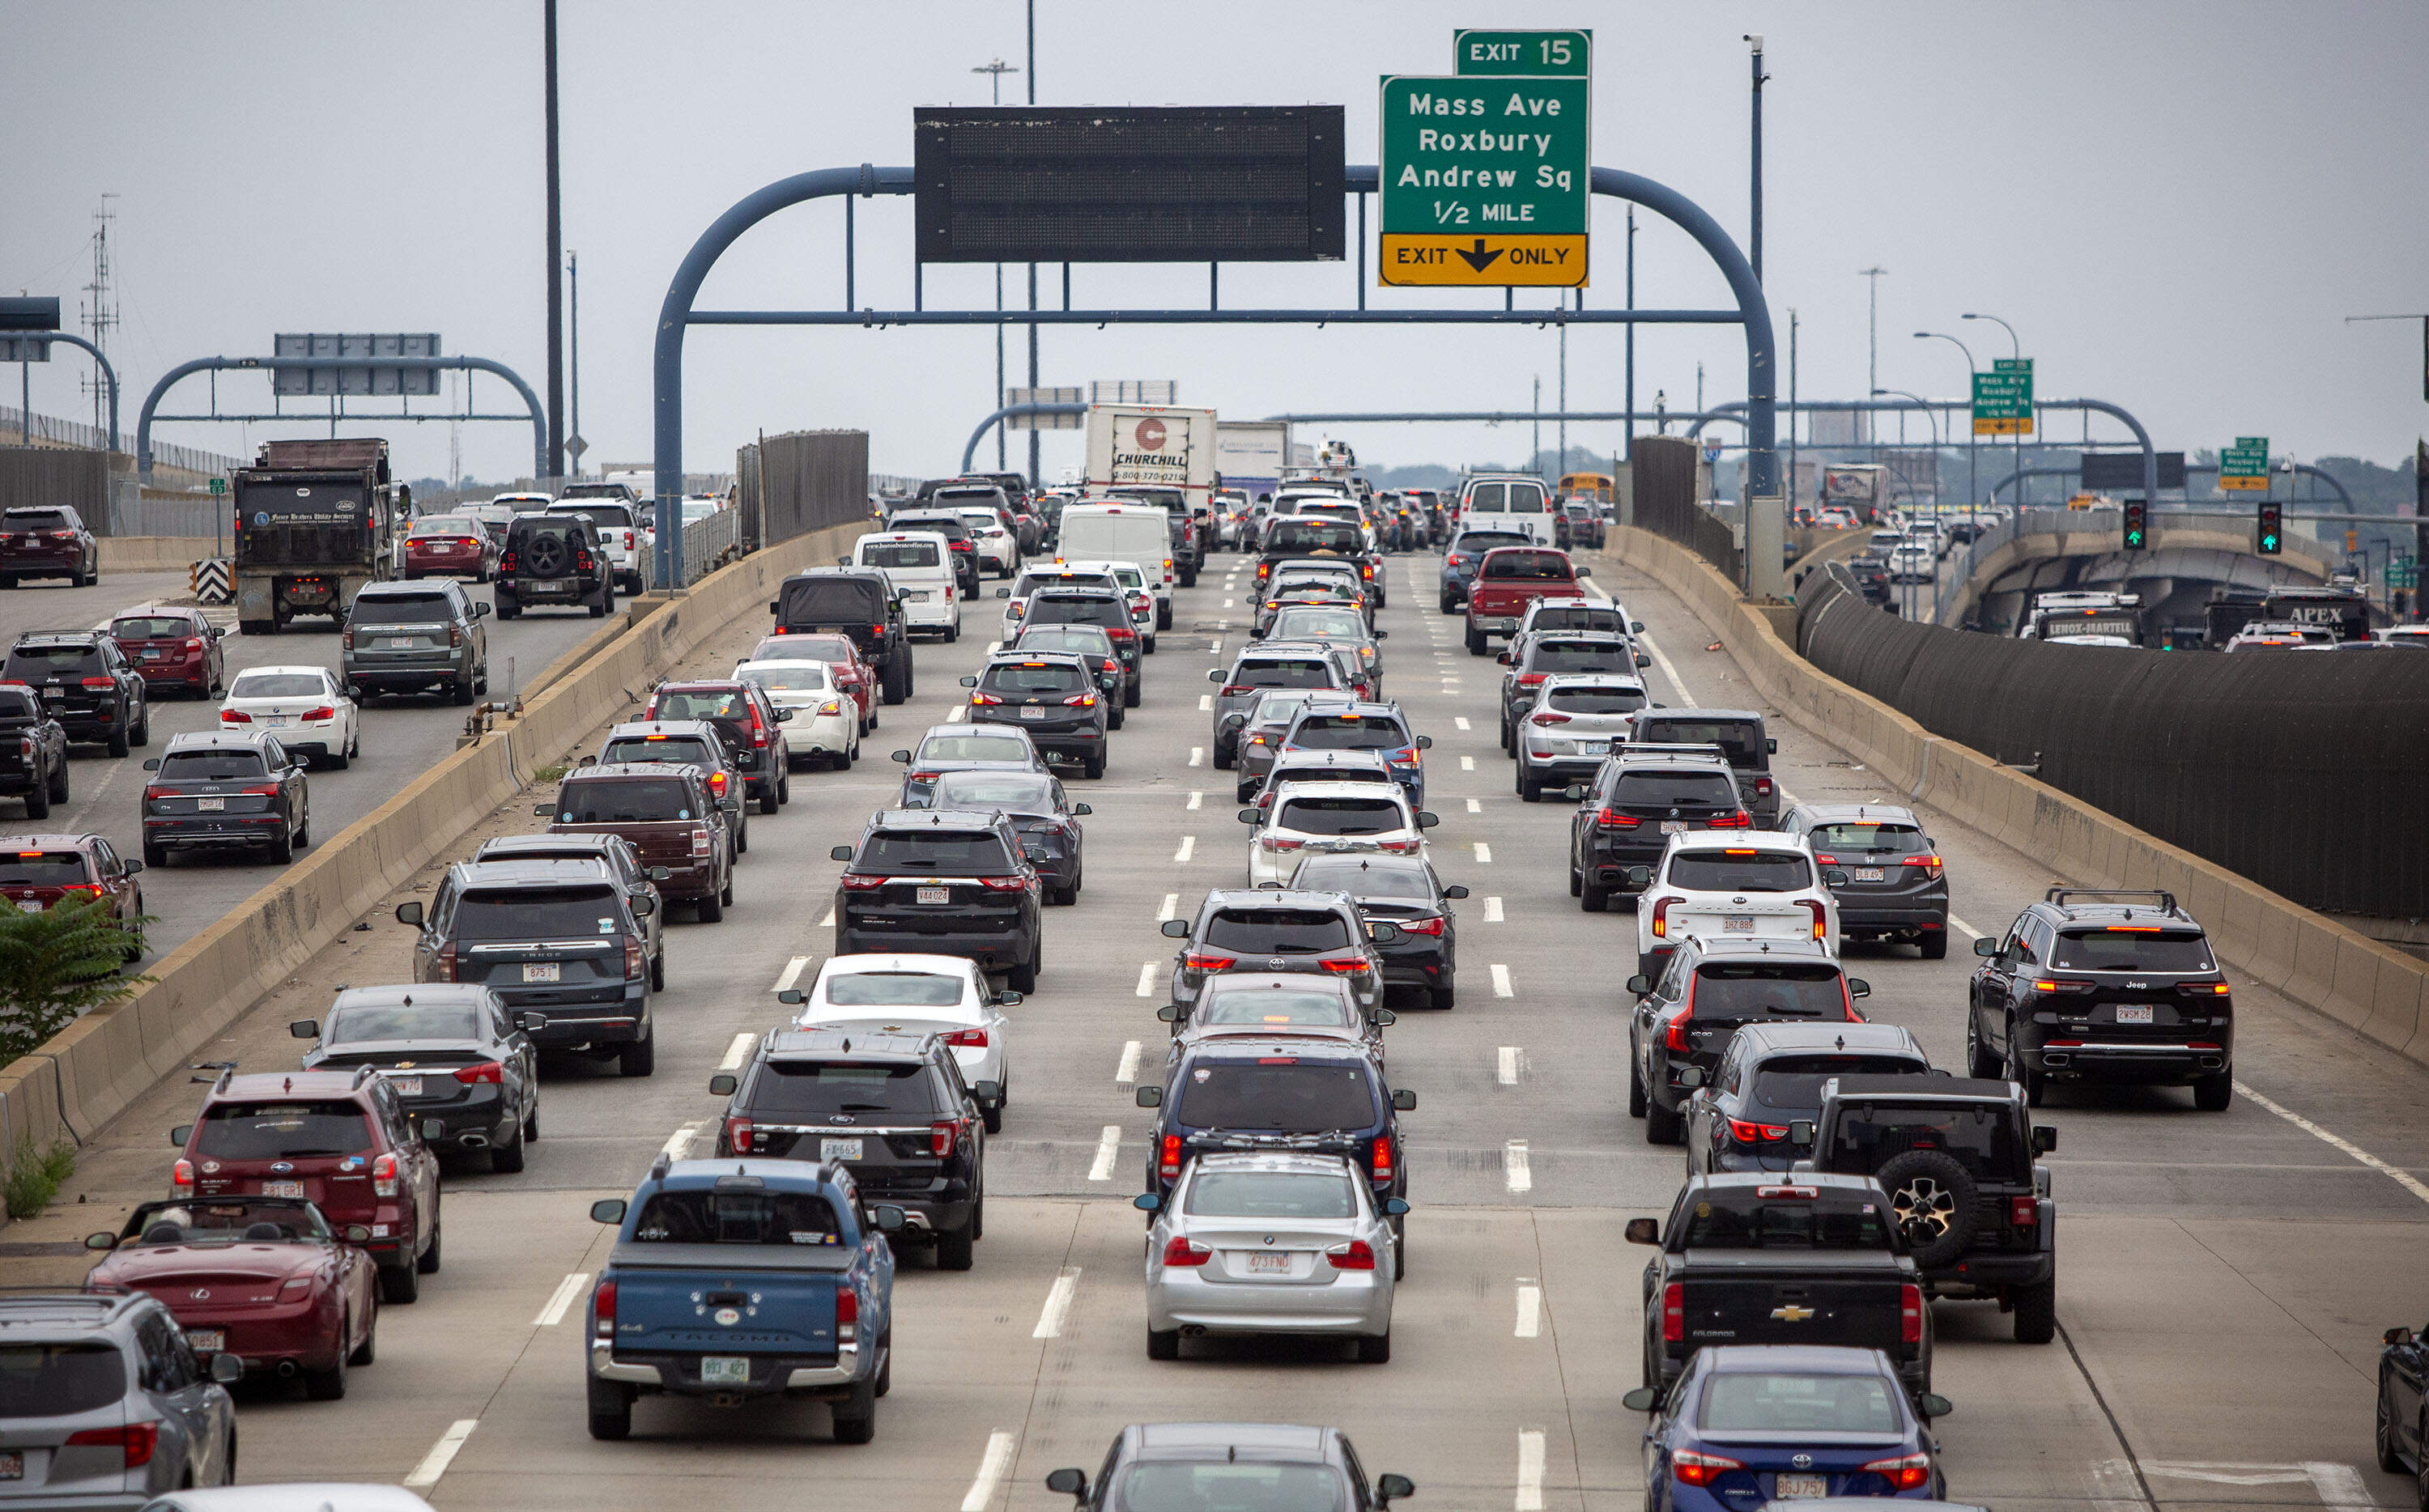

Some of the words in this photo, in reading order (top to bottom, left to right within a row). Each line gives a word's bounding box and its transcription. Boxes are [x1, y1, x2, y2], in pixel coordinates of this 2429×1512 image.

[1470, 44, 1521, 61] EXIT
[1540, 40, 1572, 65] 15
[1410, 93, 1485, 116] Mass
[1504, 93, 1561, 117] Ave
[1419, 129, 1551, 157] Roxbury
[1397, 164, 1517, 188] Andrew
[1535, 165, 1572, 192] Sq
[1434, 201, 1470, 224] 1/2
[1482, 204, 1534, 221] MILE
[1397, 248, 1448, 264] EXIT
[1510, 248, 1569, 265] ONLY
[1117, 453, 1187, 466] CHURCHILL
[2290, 608, 2343, 622] APEX
[2050, 622, 2132, 635] LENOX-MARTELL
[1725, 920, 1738, 928] 1HZ
[1740, 920, 1754, 929] 889
[530, 967, 546, 978] 875
[2125, 981, 2147, 990] Jeep
[2140, 1009, 2151, 1019] 28
[1249, 1255, 1268, 1268] 473
[671, 1334, 791, 1342] TACOMA
[1777, 1480, 1800, 1495] 8GJ
[1802, 1480, 1825, 1495] 757
